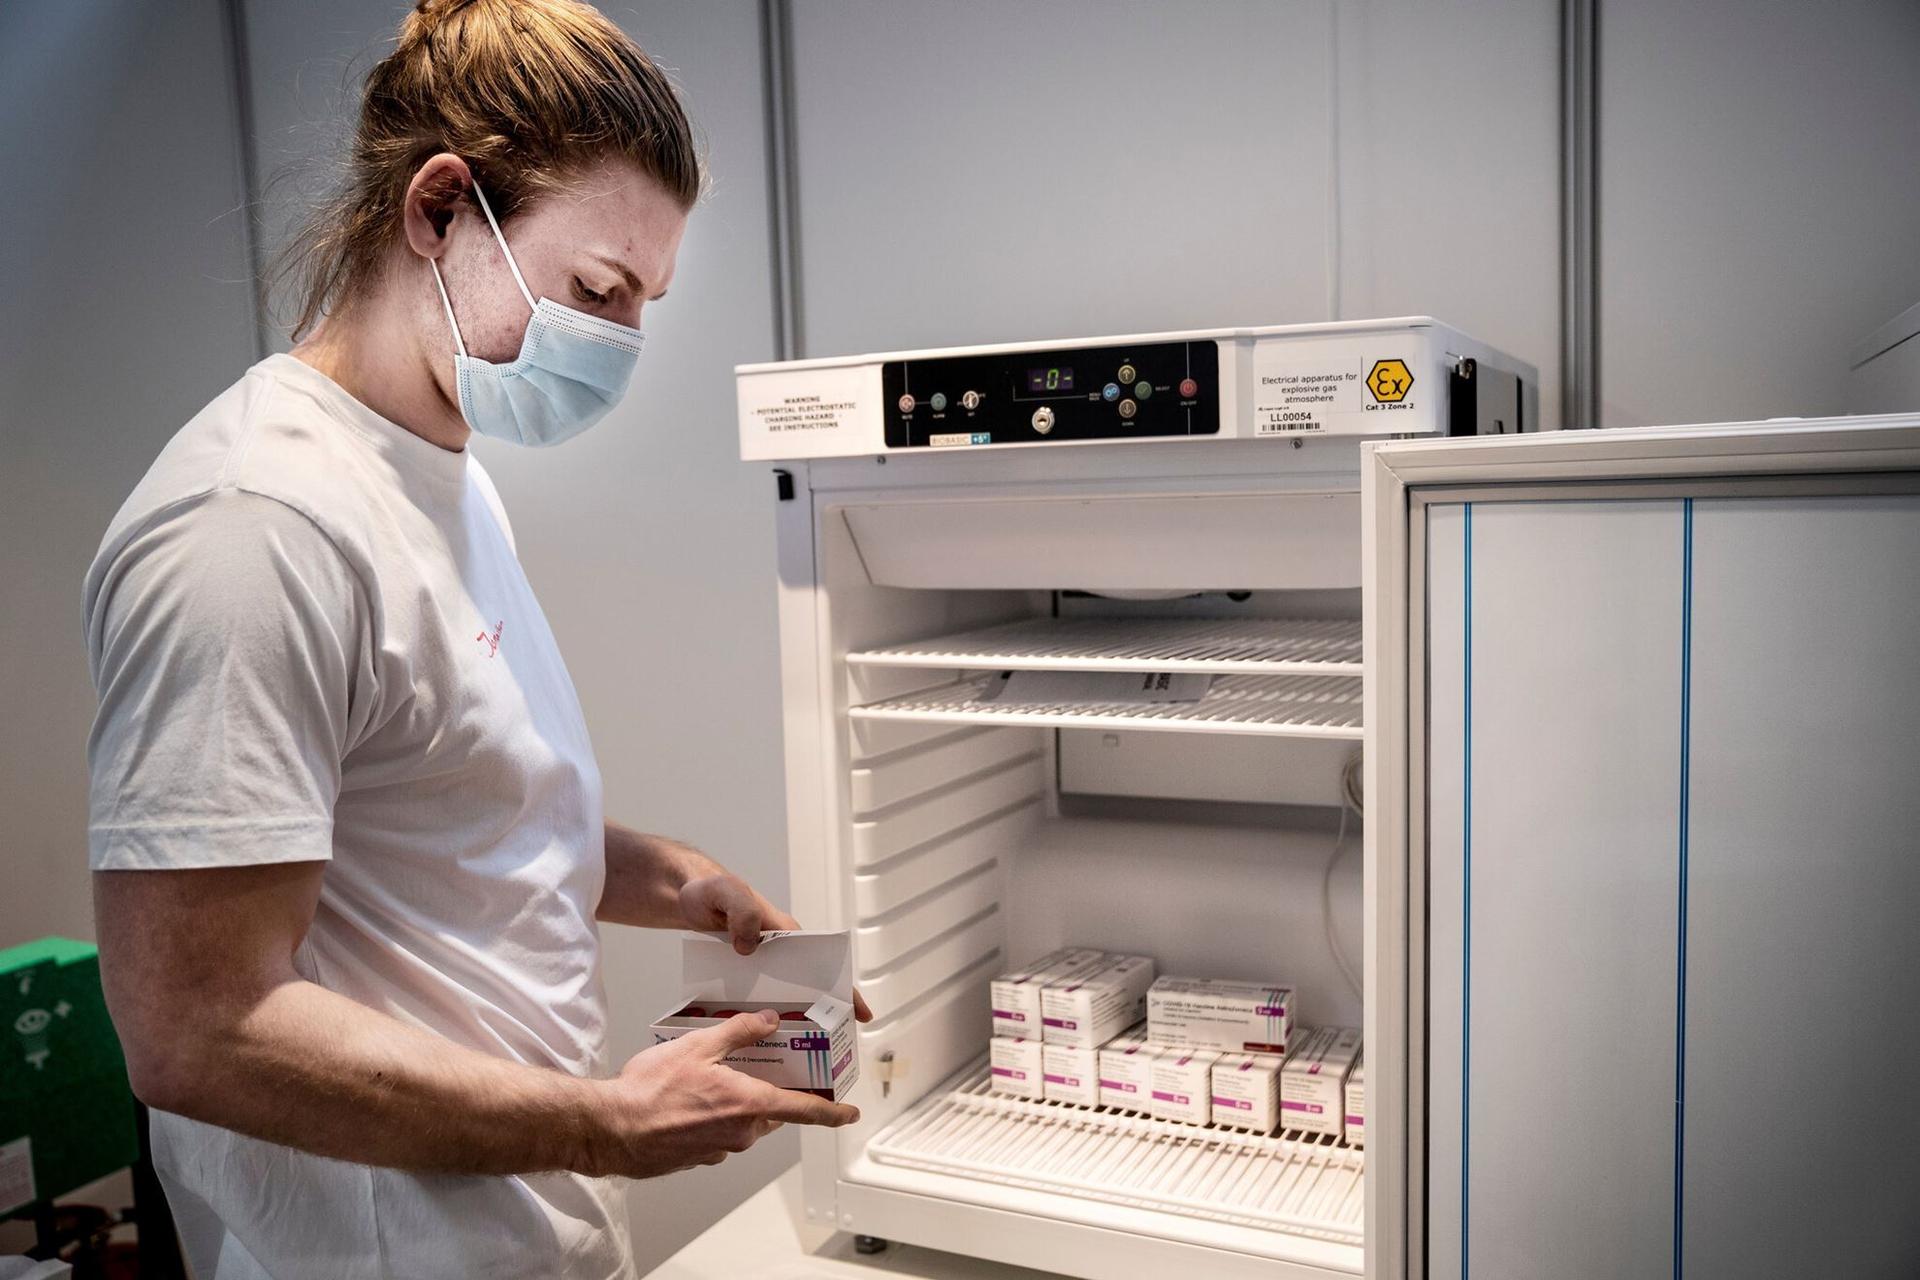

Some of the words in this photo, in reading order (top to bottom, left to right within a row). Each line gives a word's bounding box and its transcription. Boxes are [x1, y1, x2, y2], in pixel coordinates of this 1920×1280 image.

[1261, 375, 1299, 385] Electrical
[1301, 374, 1343, 385] apparatus
[1345, 372, 1357, 381] for
[1281, 385, 1320, 395] explosive
[1322, 385, 1338, 394] gas
[784, 396, 820, 404] WARNING
[1284, 395, 1334, 404] atmosphere
[757, 406, 796, 416] POTENTIAL
[798, 402, 857, 413] ELECTROSTATIC
[765, 415, 803, 424] CHARGING
[805, 413, 835, 421] HAZARD
[1270, 412, 1312, 422] LL00054
[784, 421, 839, 431] INSTRUCTIONS
[794, 1039, 801, 1048] 5
